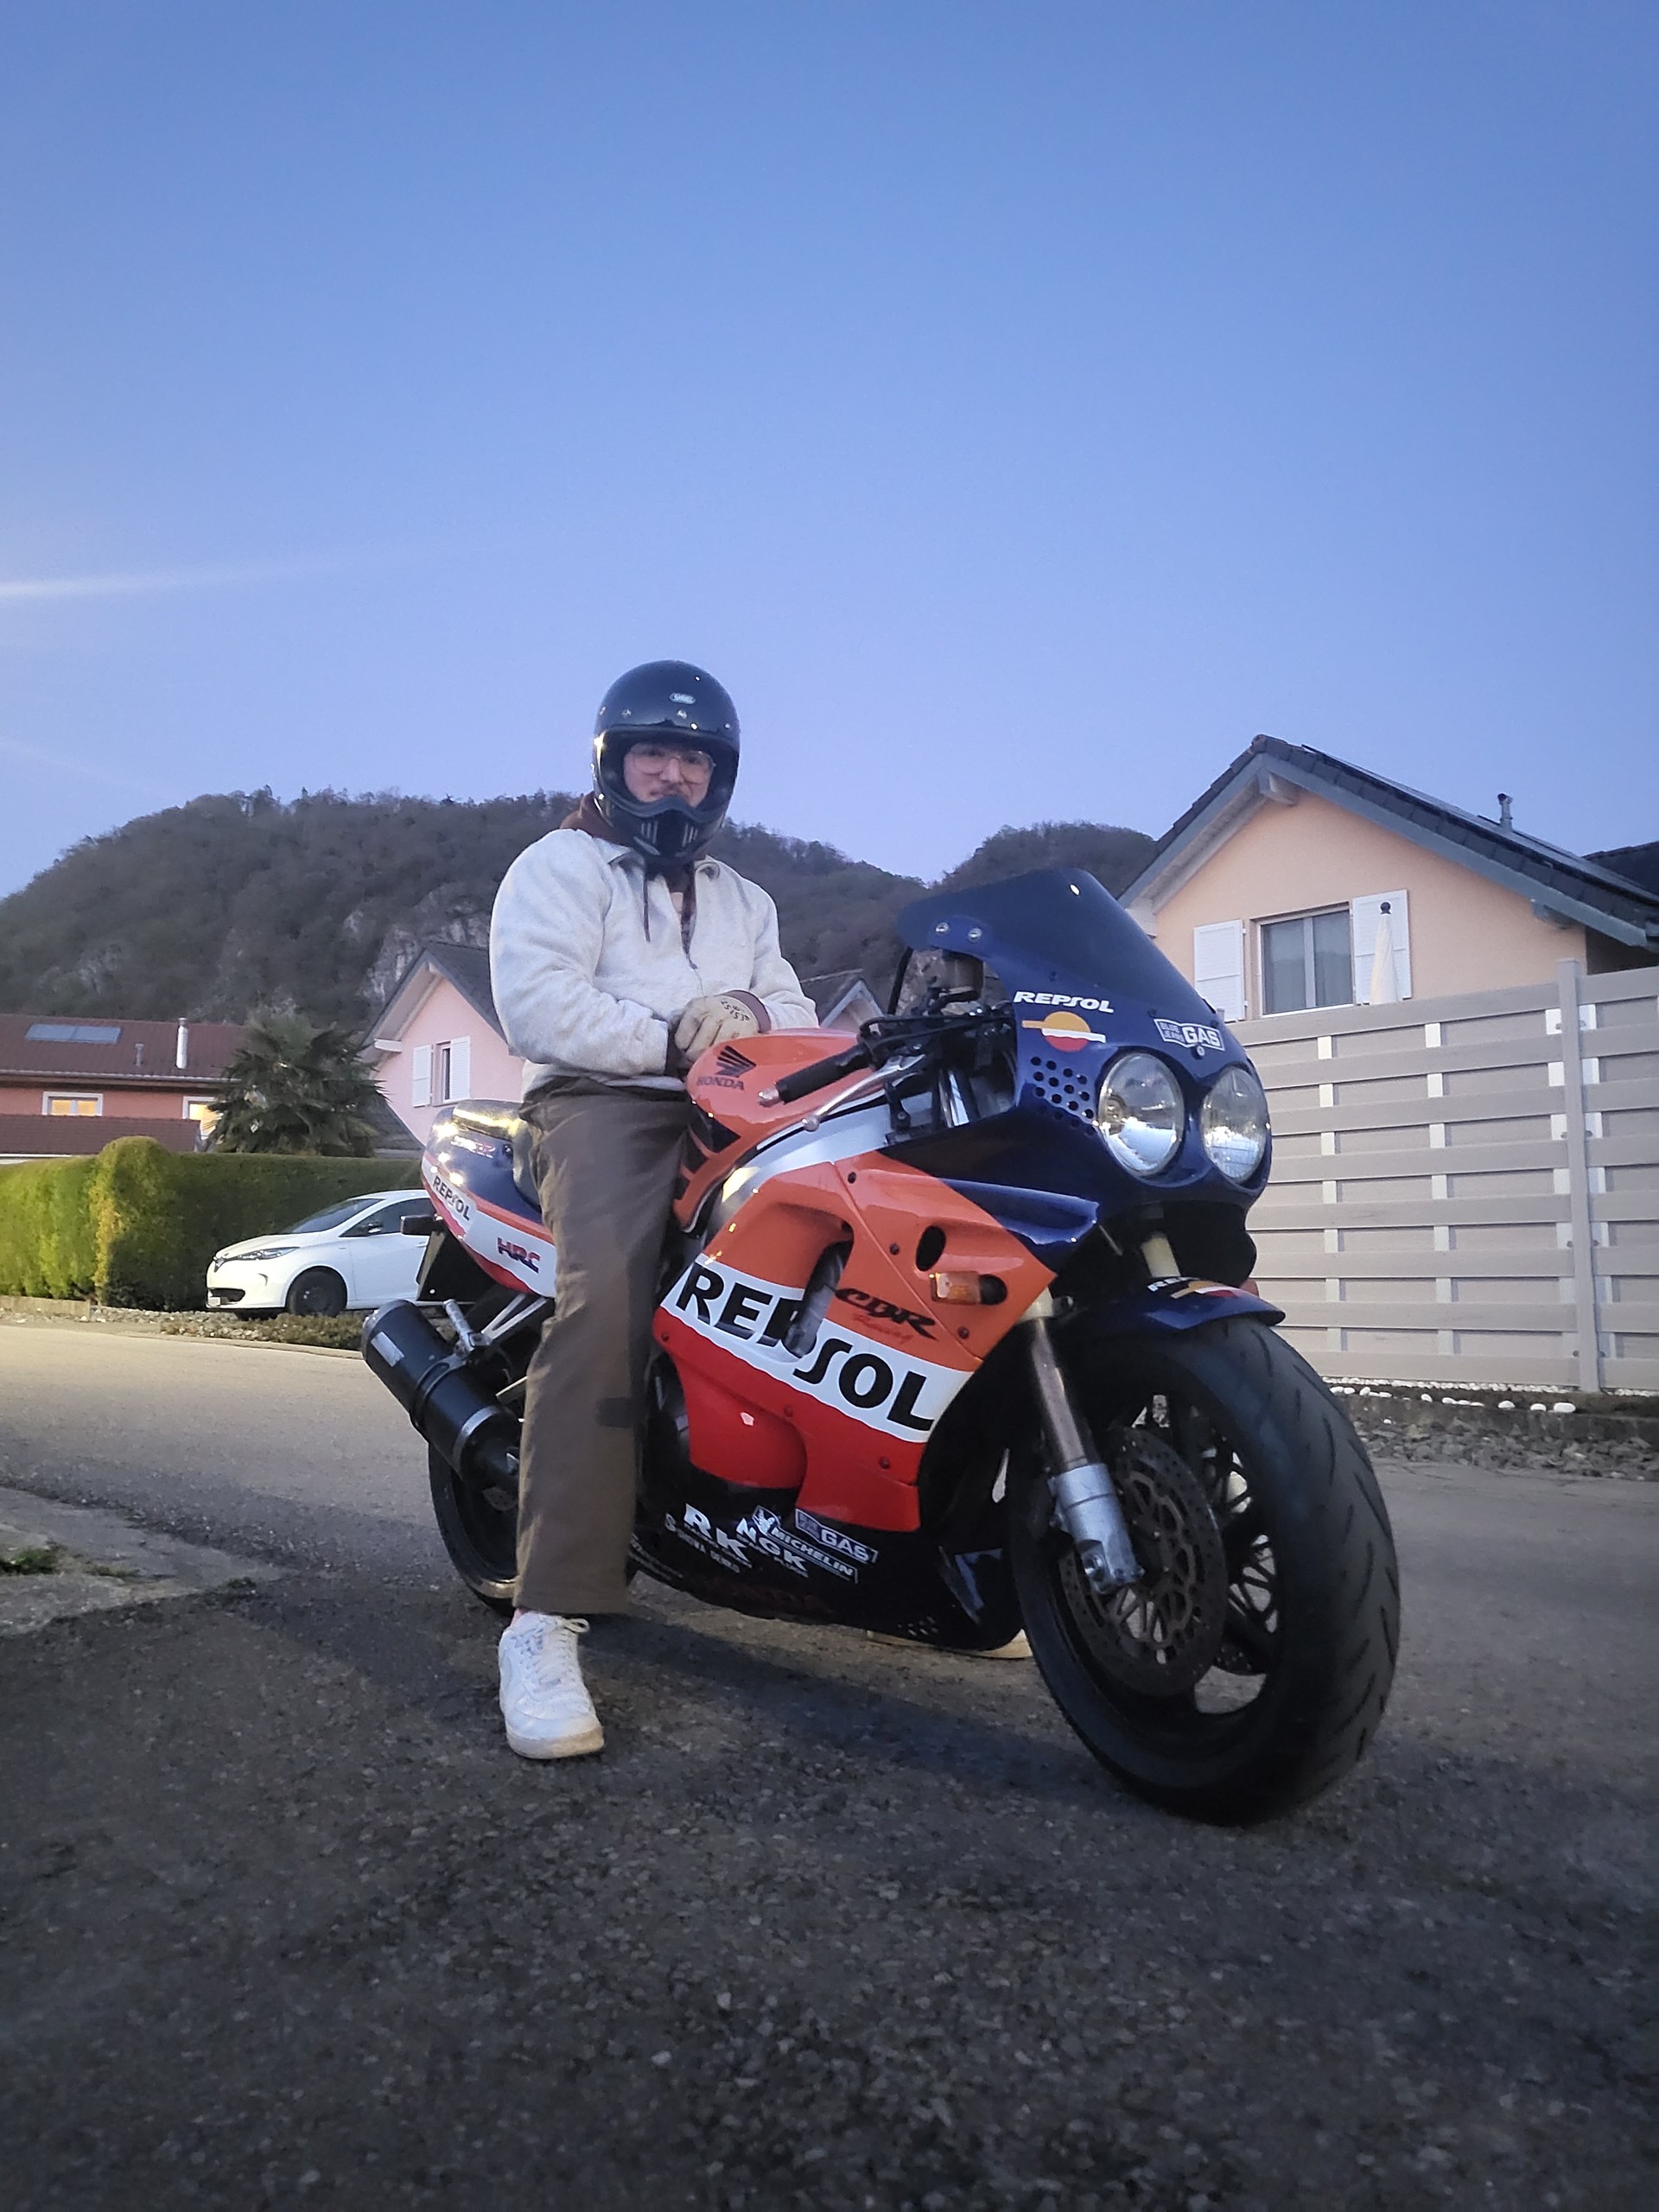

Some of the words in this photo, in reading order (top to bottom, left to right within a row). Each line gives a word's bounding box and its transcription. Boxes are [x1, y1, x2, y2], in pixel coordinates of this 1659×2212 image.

[1013, 990, 1115, 1013] REPSOL
[1181, 1027, 1222, 1047] GAS
[696, 1077, 745, 1090] HONDA
[497, 1236, 541, 1274] HRC
[835, 1288, 939, 1342] CBR
[683, 1503, 752, 1563] RK
[736, 1517, 808, 1573] NGK
[771, 1527, 854, 1576] MICHELIN
[821, 1529, 869, 1561] GAS
